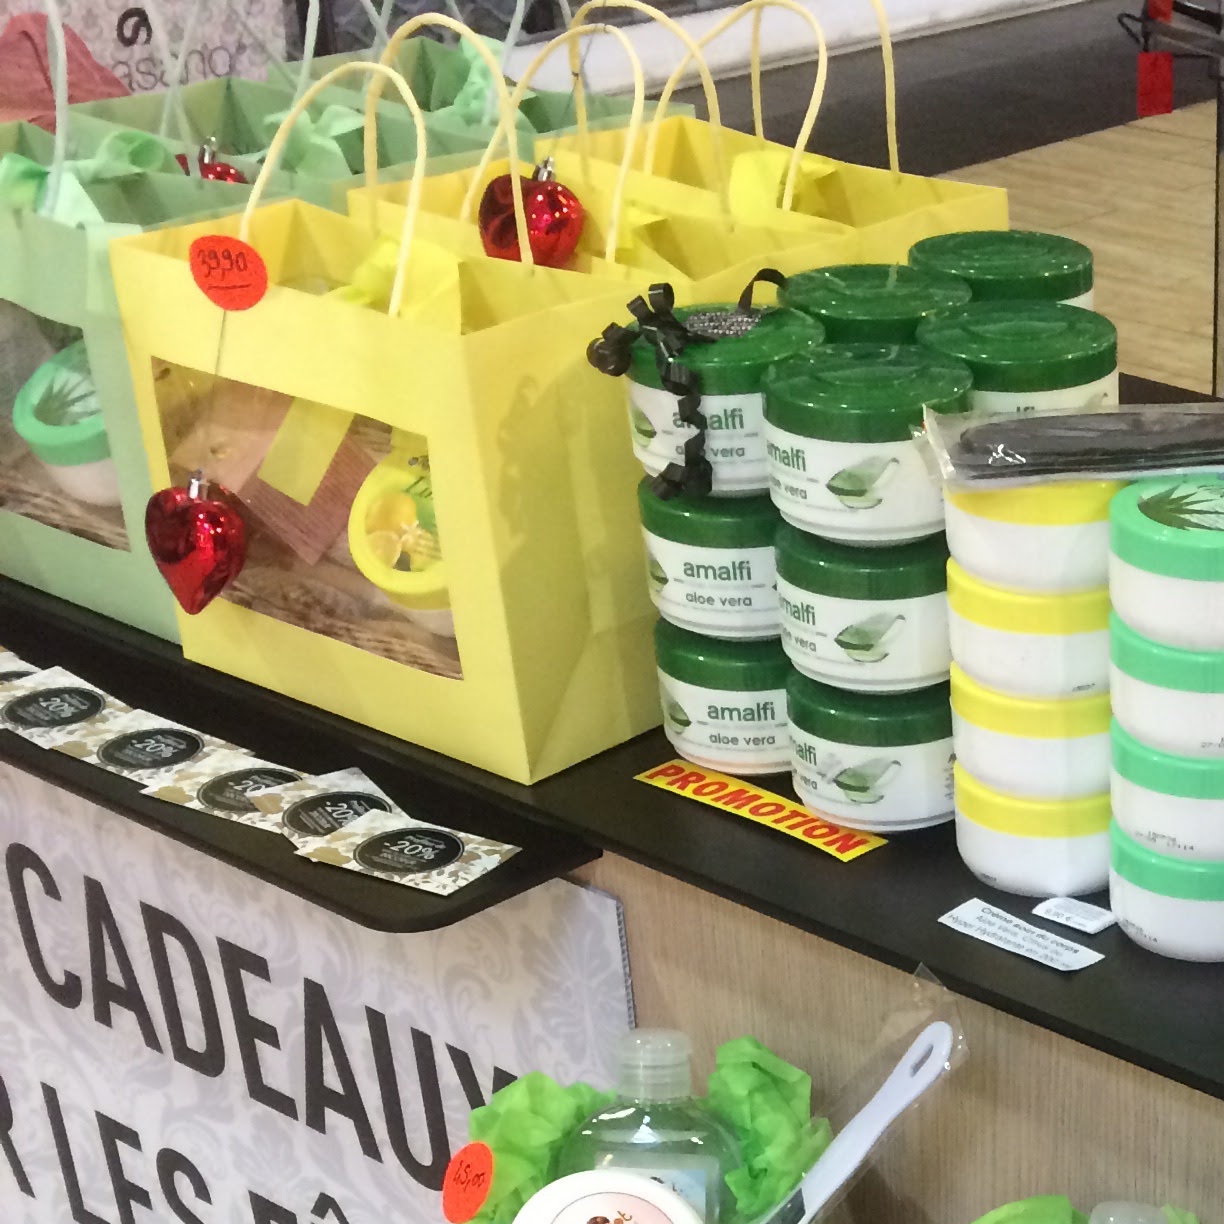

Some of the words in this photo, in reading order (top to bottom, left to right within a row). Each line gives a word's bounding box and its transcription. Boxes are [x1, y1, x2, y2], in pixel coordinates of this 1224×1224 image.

[672, 408, 744, 431] aalfi
[683, 561, 753, 582] amalfi
[685, 591, 716, 606] aloe
[719, 594, 753, 607] vera
[707, 701, 776, 722] amalfi
[709, 733, 740, 746] aloe
[743, 735, 776, 746] vera
[647, 763, 871, 855] PROMOTION
